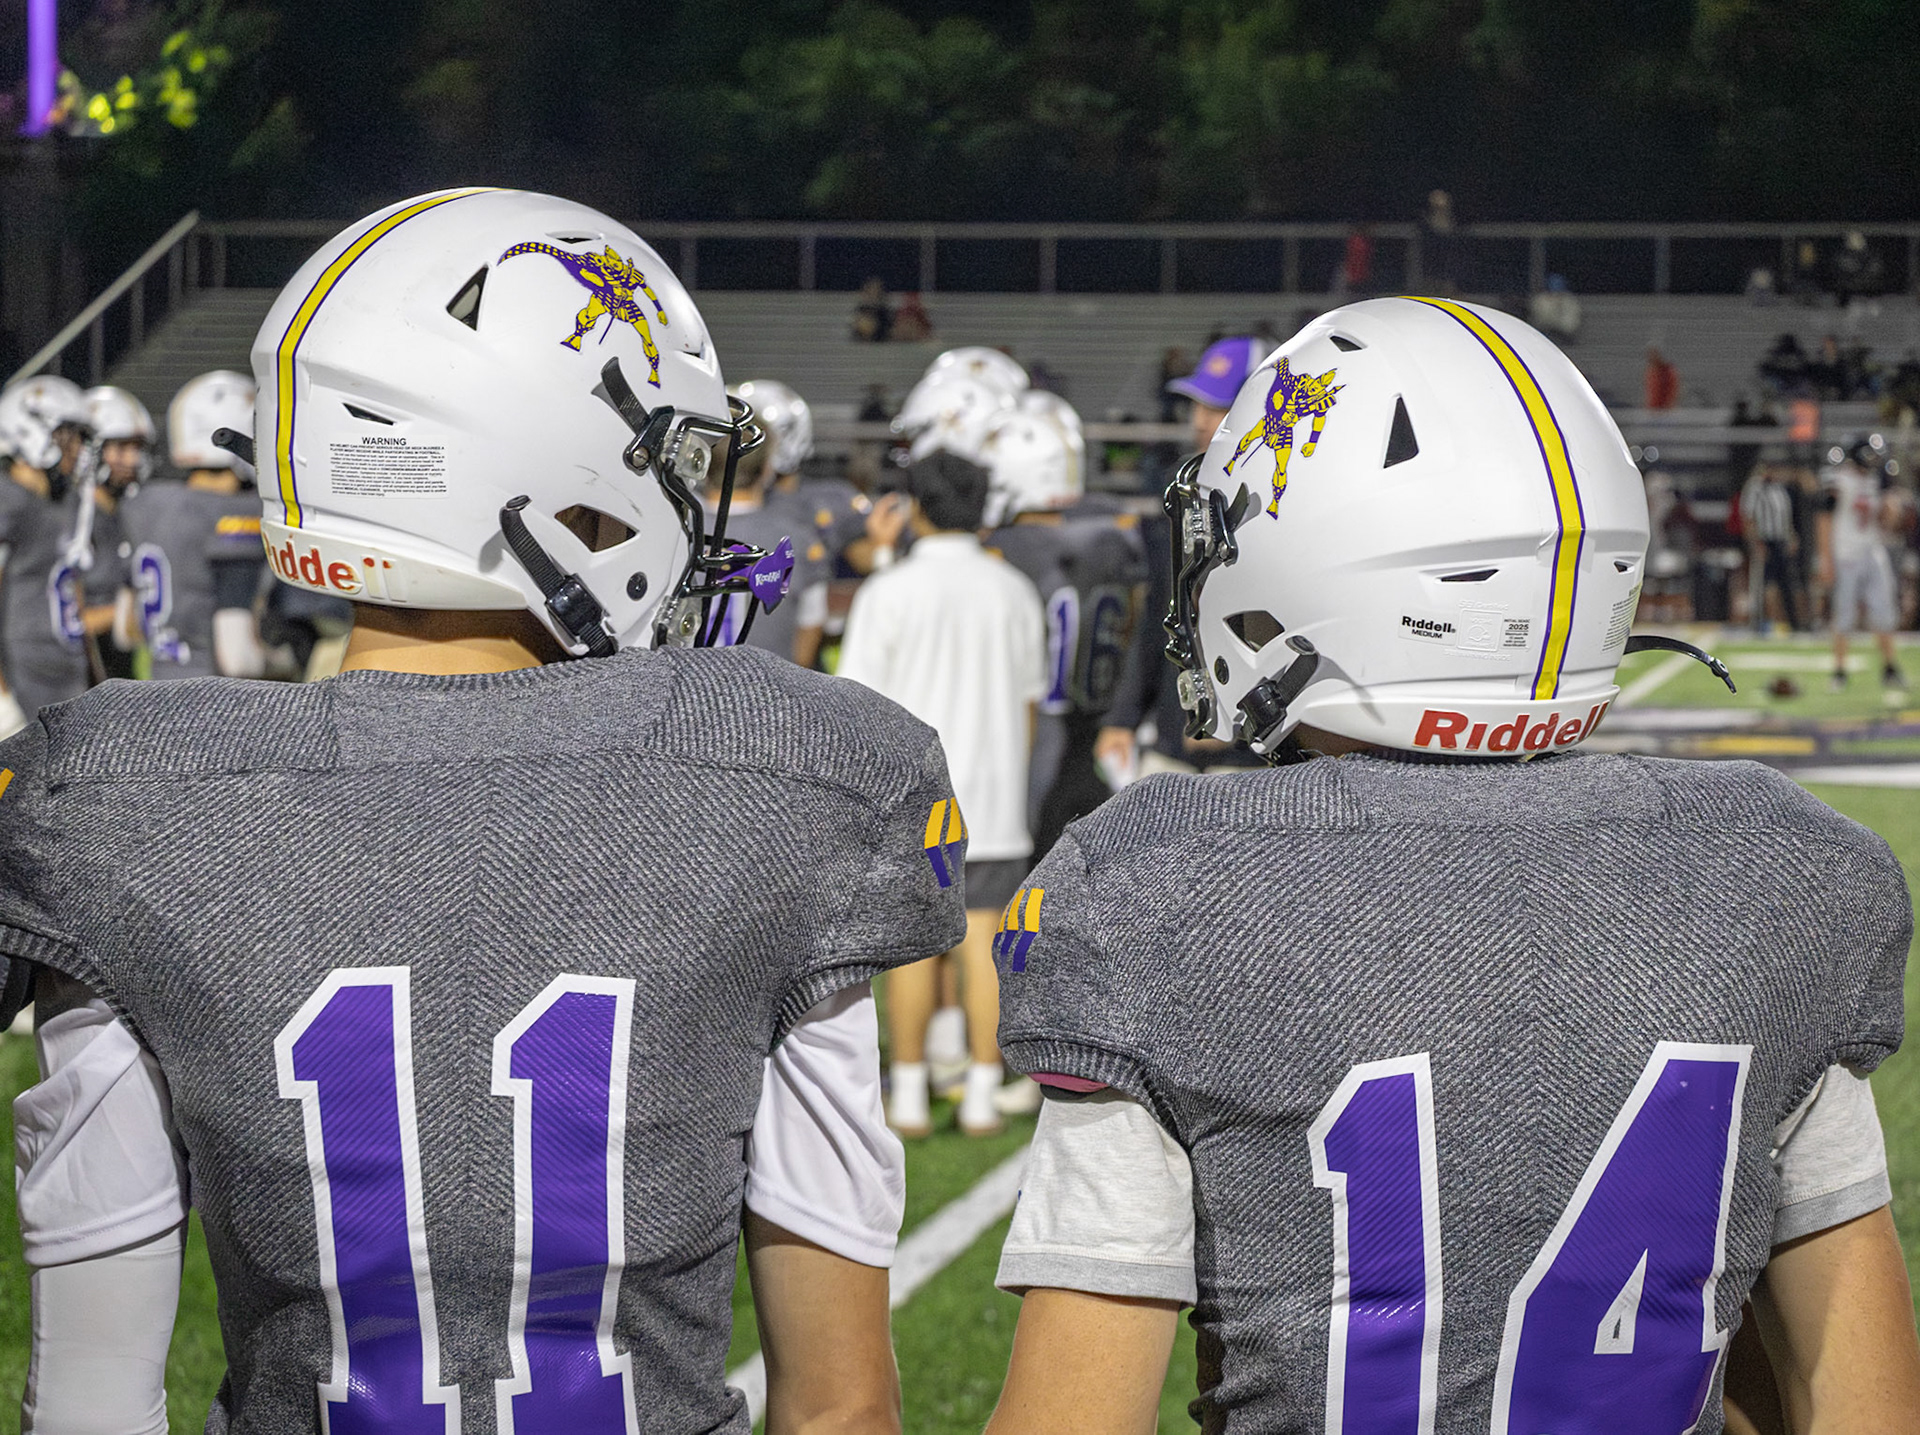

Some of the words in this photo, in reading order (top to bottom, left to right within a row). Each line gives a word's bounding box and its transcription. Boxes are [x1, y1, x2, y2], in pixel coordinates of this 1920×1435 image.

[362, 437, 407, 446] WARNING
[1402, 616, 1451, 633] Riddell
[1508, 623, 1529, 631] 2025
[1412, 629, 1443, 639] MEDIUM
[1412, 701, 1610, 752] Riddell
[274, 966, 638, 1435] 11
[1307, 1040, 1754, 1435] 14
